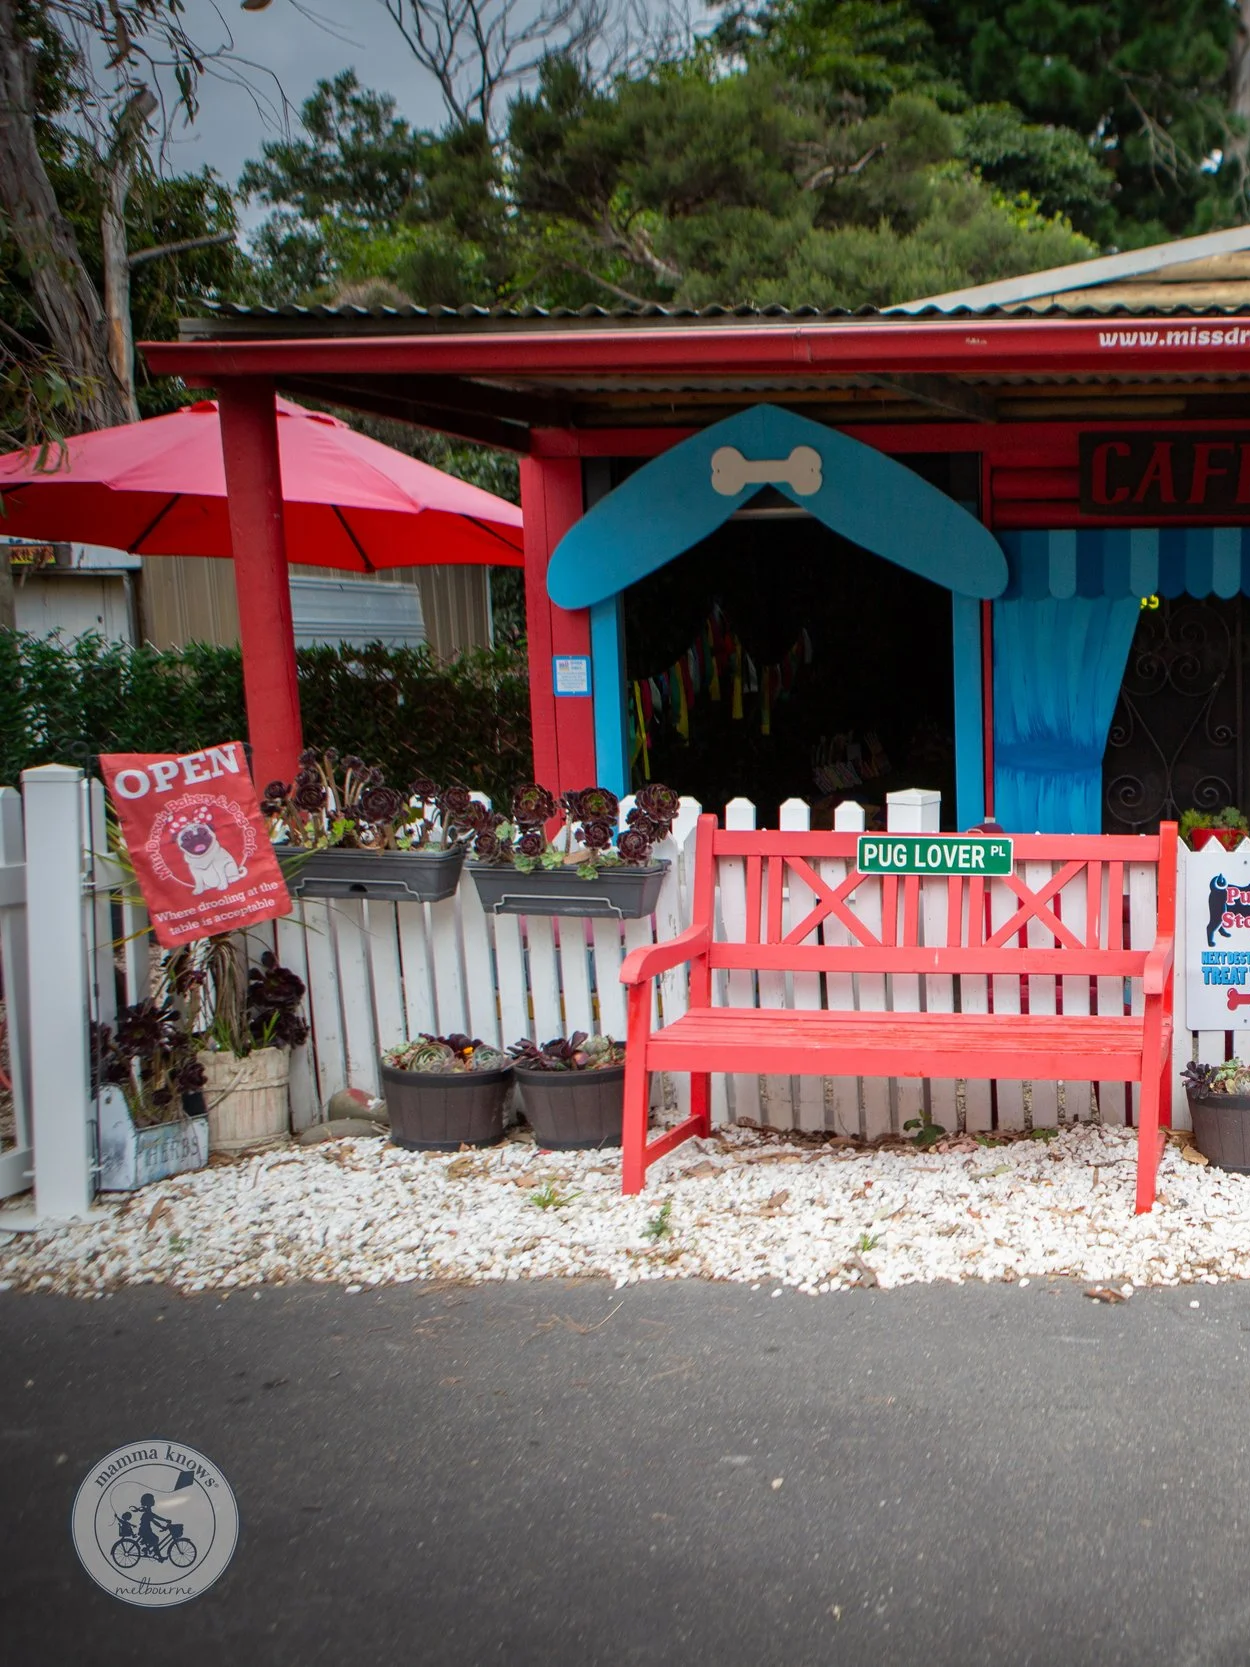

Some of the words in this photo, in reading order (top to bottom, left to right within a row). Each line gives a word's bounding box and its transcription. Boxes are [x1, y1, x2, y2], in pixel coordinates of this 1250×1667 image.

[114, 744, 240, 799] OPEN
[164, 793, 215, 813] Bakery
[227, 800, 249, 828] Dog
[863, 843, 908, 868] PUG
[914, 844, 985, 869] LOVER
[990, 845, 1006, 857] PL
[155, 907, 196, 922] Where
[197, 891, 246, 912] drooling
[247, 887, 259, 897] at
[260, 880, 279, 893] the
[169, 920, 200, 936] table
[202, 916, 213, 926] is
[214, 898, 276, 923] acceptable
[1201, 951, 1226, 965] NEXT
[1202, 967, 1248, 986] TREAT
